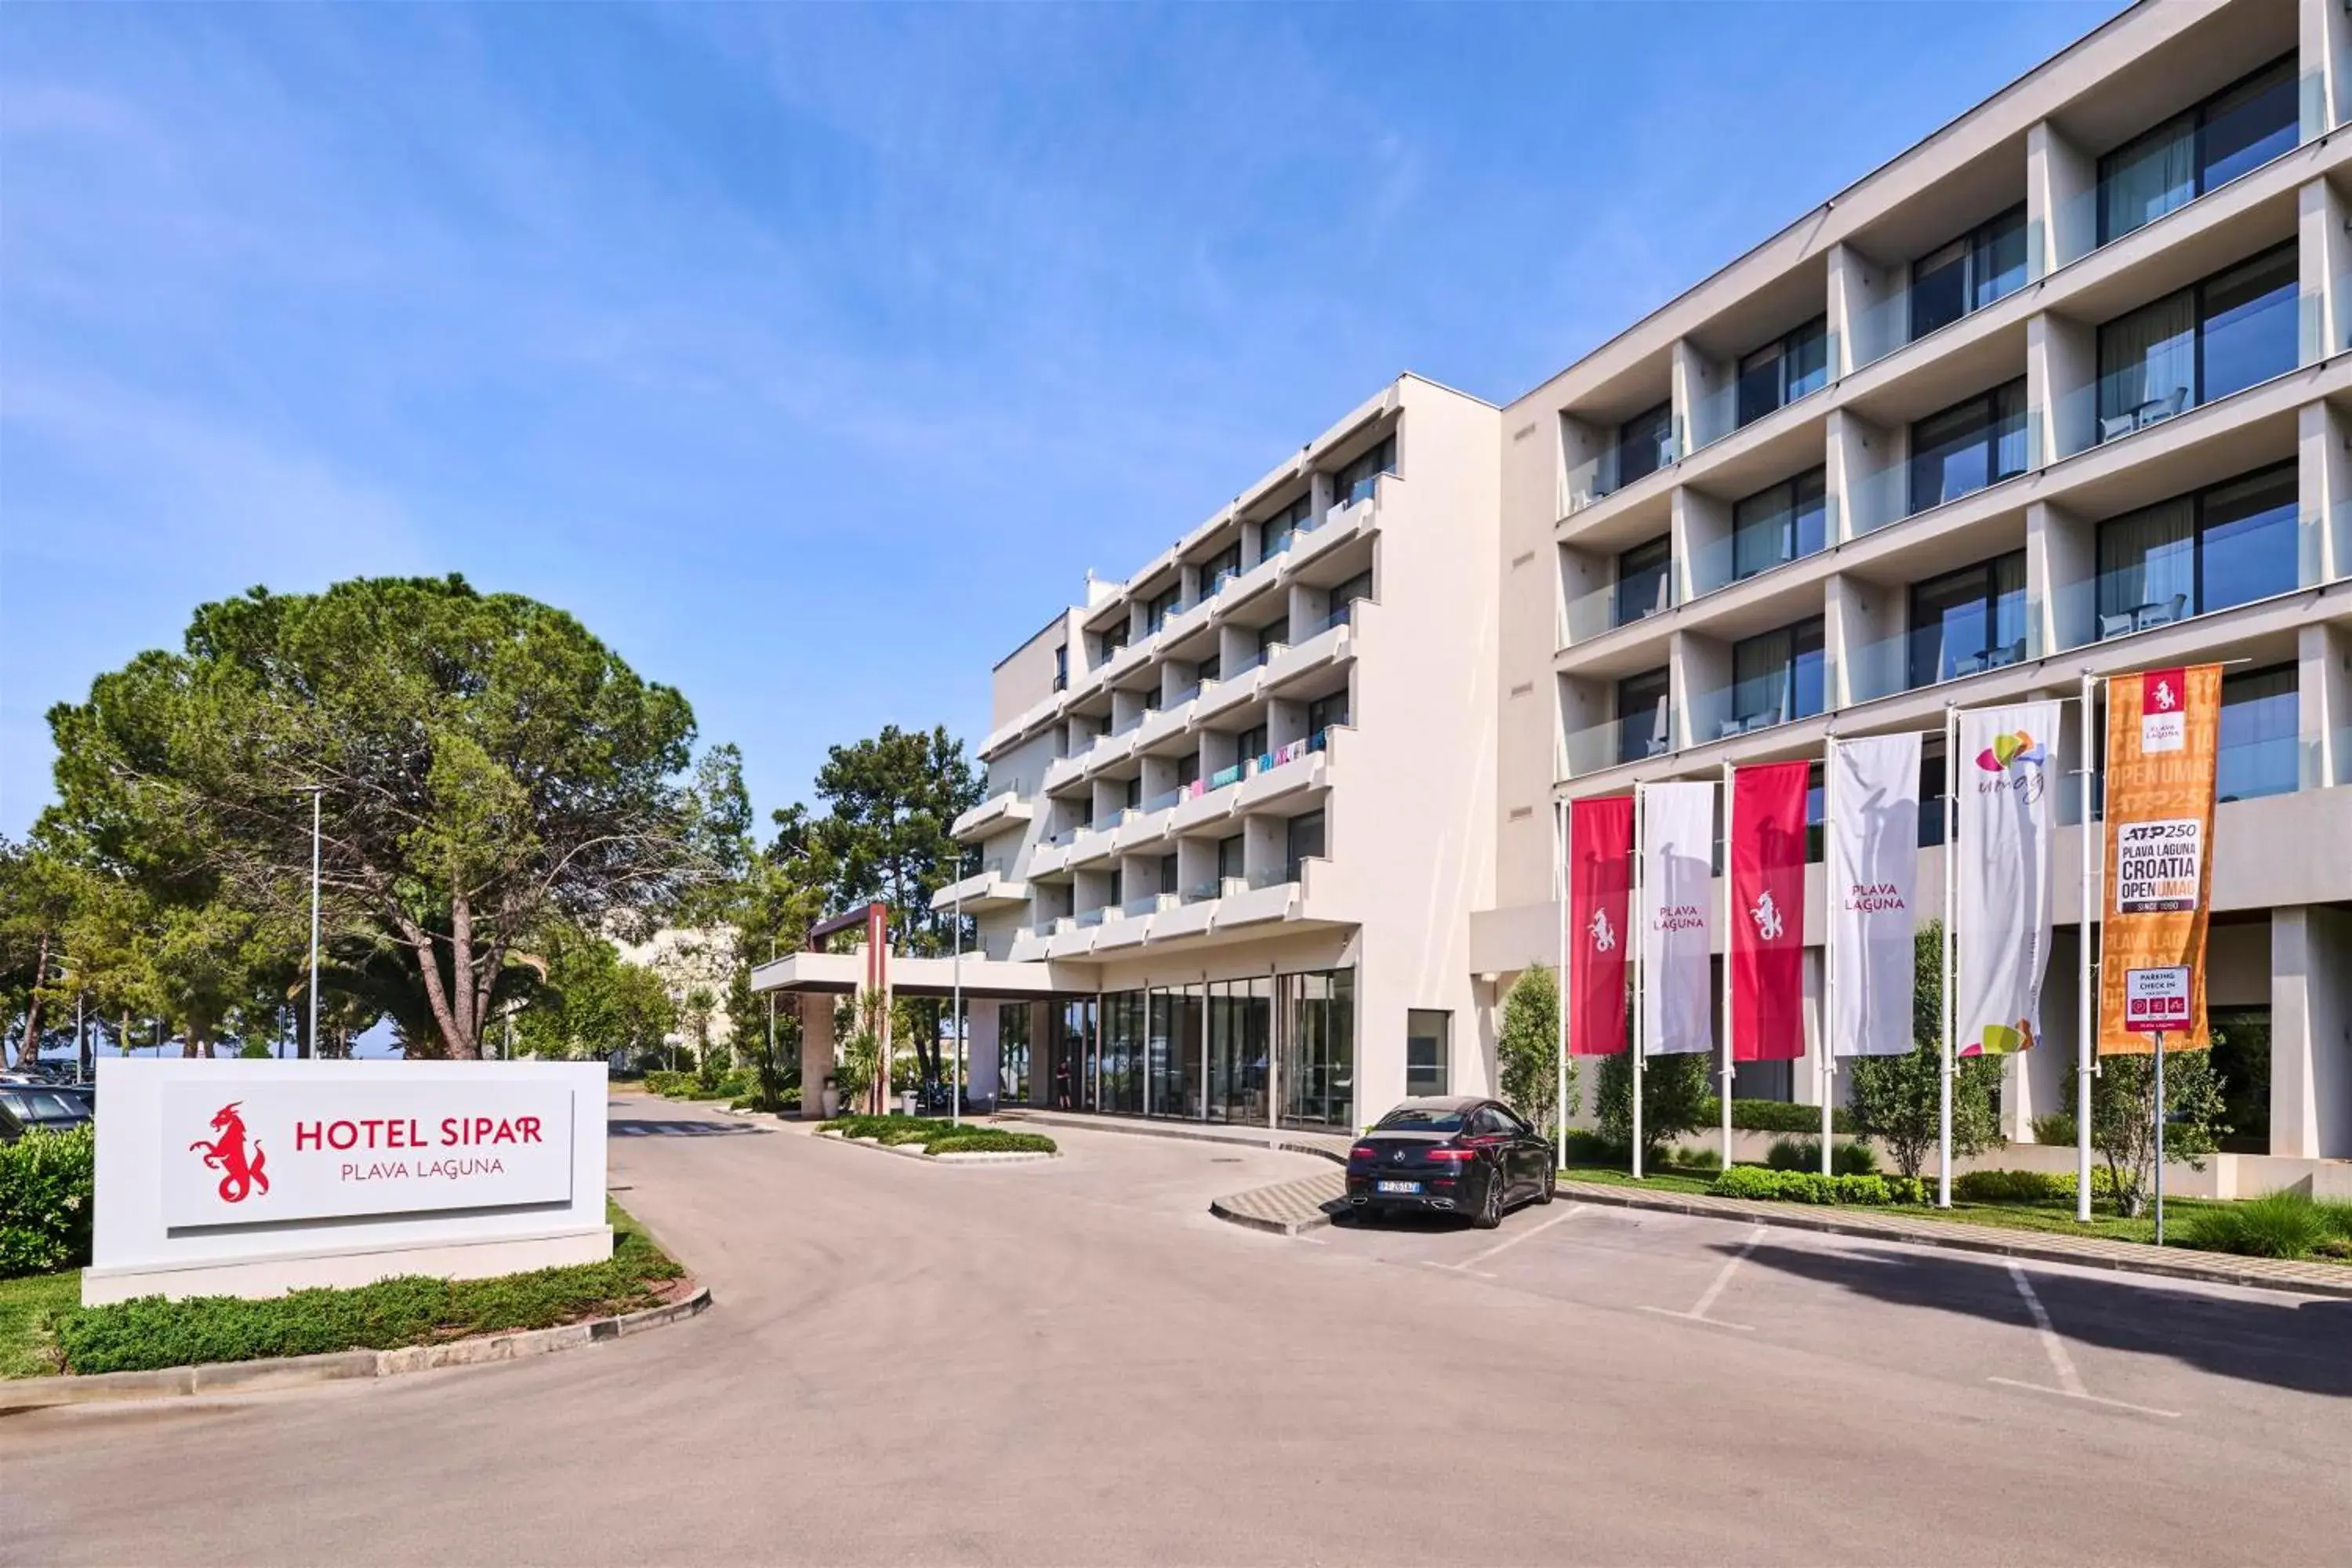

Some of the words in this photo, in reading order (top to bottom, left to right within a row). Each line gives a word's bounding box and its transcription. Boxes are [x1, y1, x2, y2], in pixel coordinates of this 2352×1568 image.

[1978, 773, 2044, 805] umag
[2123, 844, 2154, 858] PLAVA
[2157, 843, 2195, 856] LAGUNA
[2123, 858, 2194, 880] CROATIA
[1853, 884, 1896, 895] PLAVA
[1660, 906, 1697, 916] PLAVA
[1845, 898, 1904, 913] LAGUNA
[1653, 918, 1704, 931] LAGUNA
[296, 1120, 428, 1151] HOTEL
[441, 1115, 543, 1145] SIPAR
[341, 1162, 409, 1181] PLAVA
[418, 1159, 505, 1180] LAGUNA
